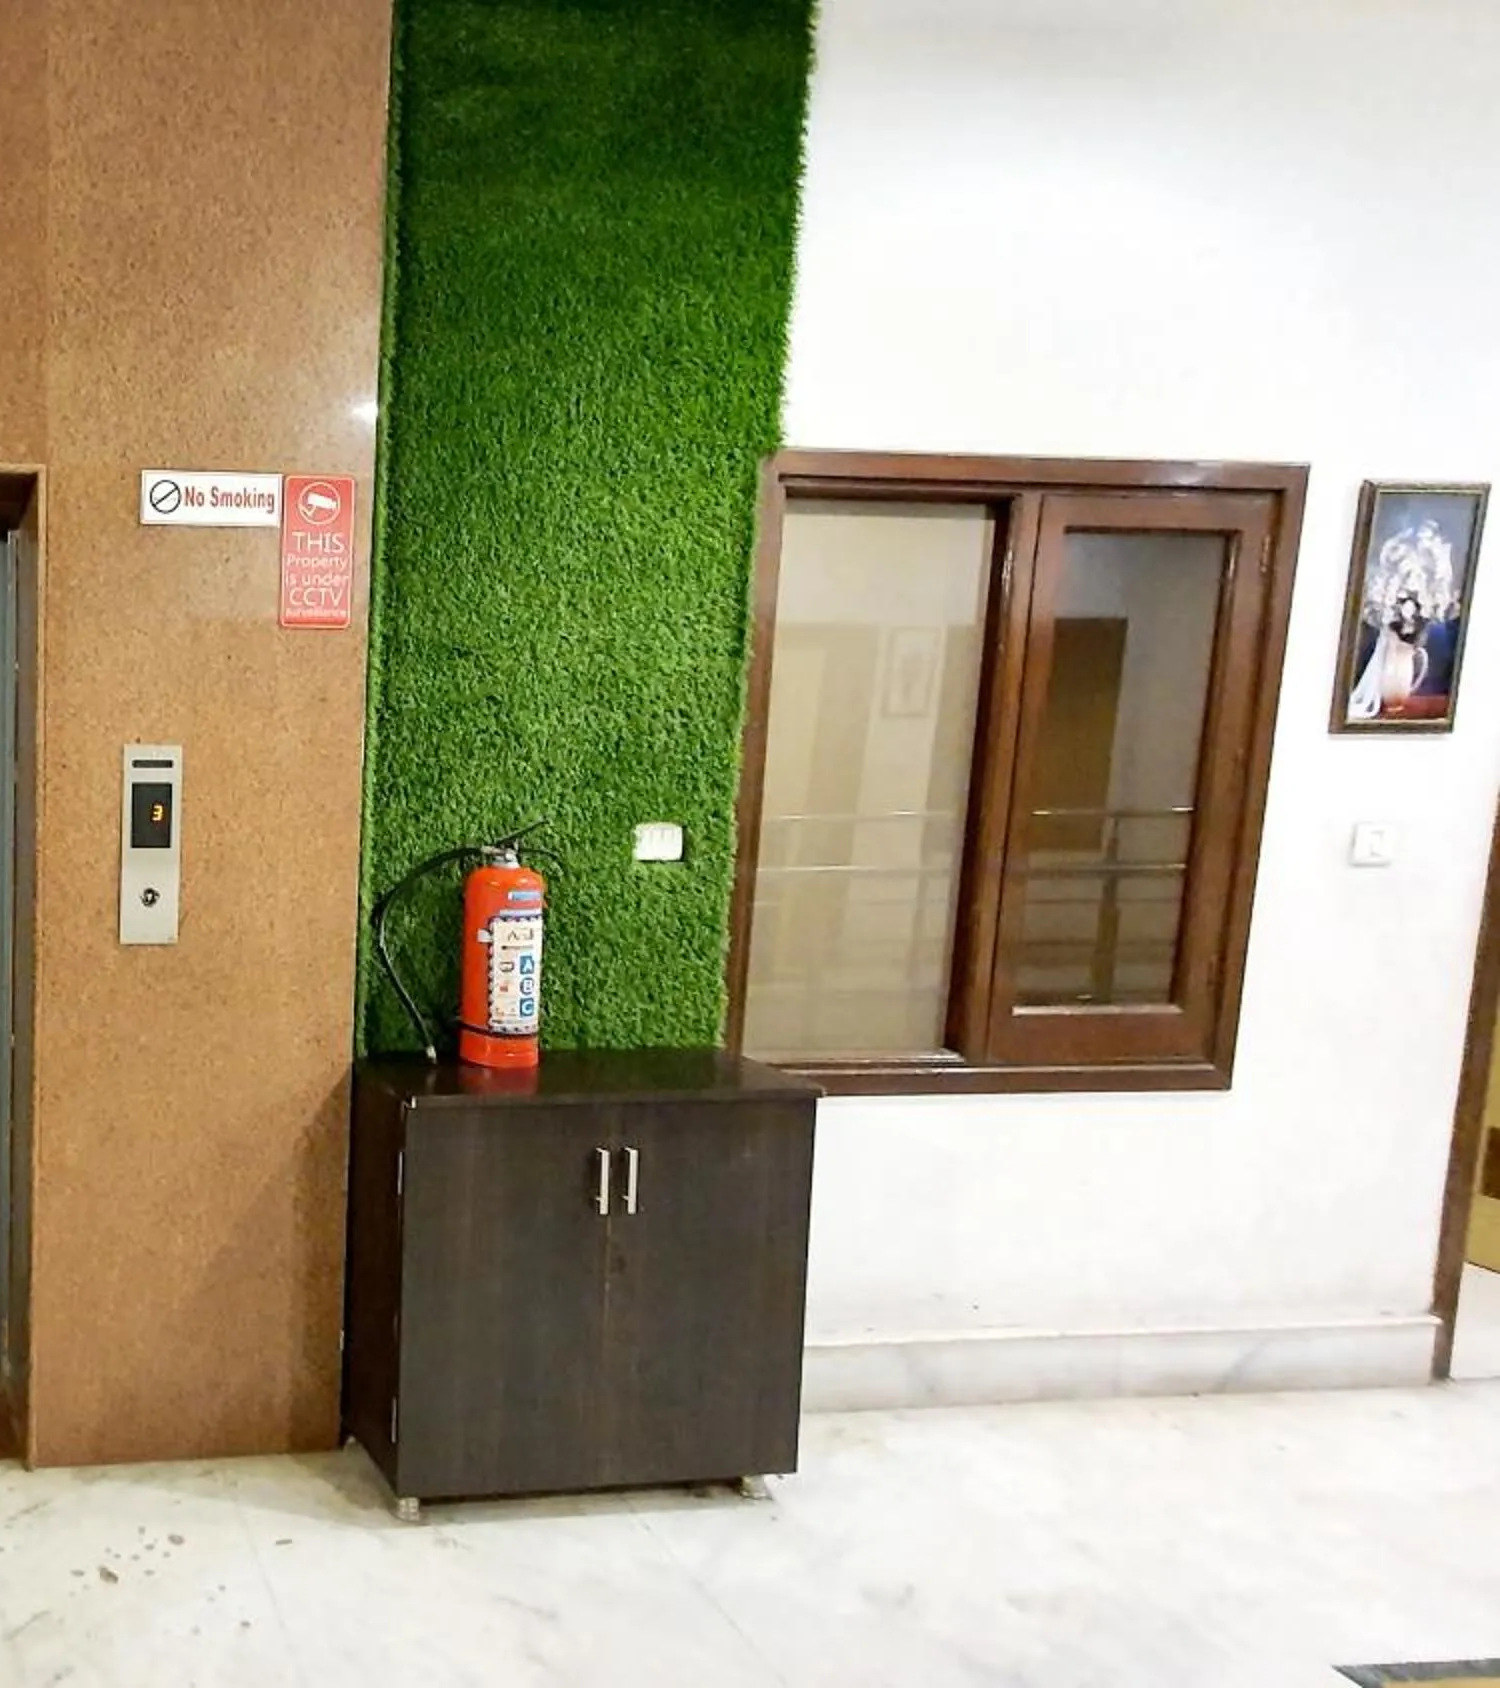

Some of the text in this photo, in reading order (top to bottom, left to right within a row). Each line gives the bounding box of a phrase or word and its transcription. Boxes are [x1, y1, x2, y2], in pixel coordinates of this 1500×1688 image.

[184, 486, 275, 514] No Smoking
[291, 531, 345, 553] THIS
[287, 553, 348, 571] Property
[301, 570, 349, 587] under
[289, 587, 343, 606] CCTV
[152, 805, 163, 821] 3
